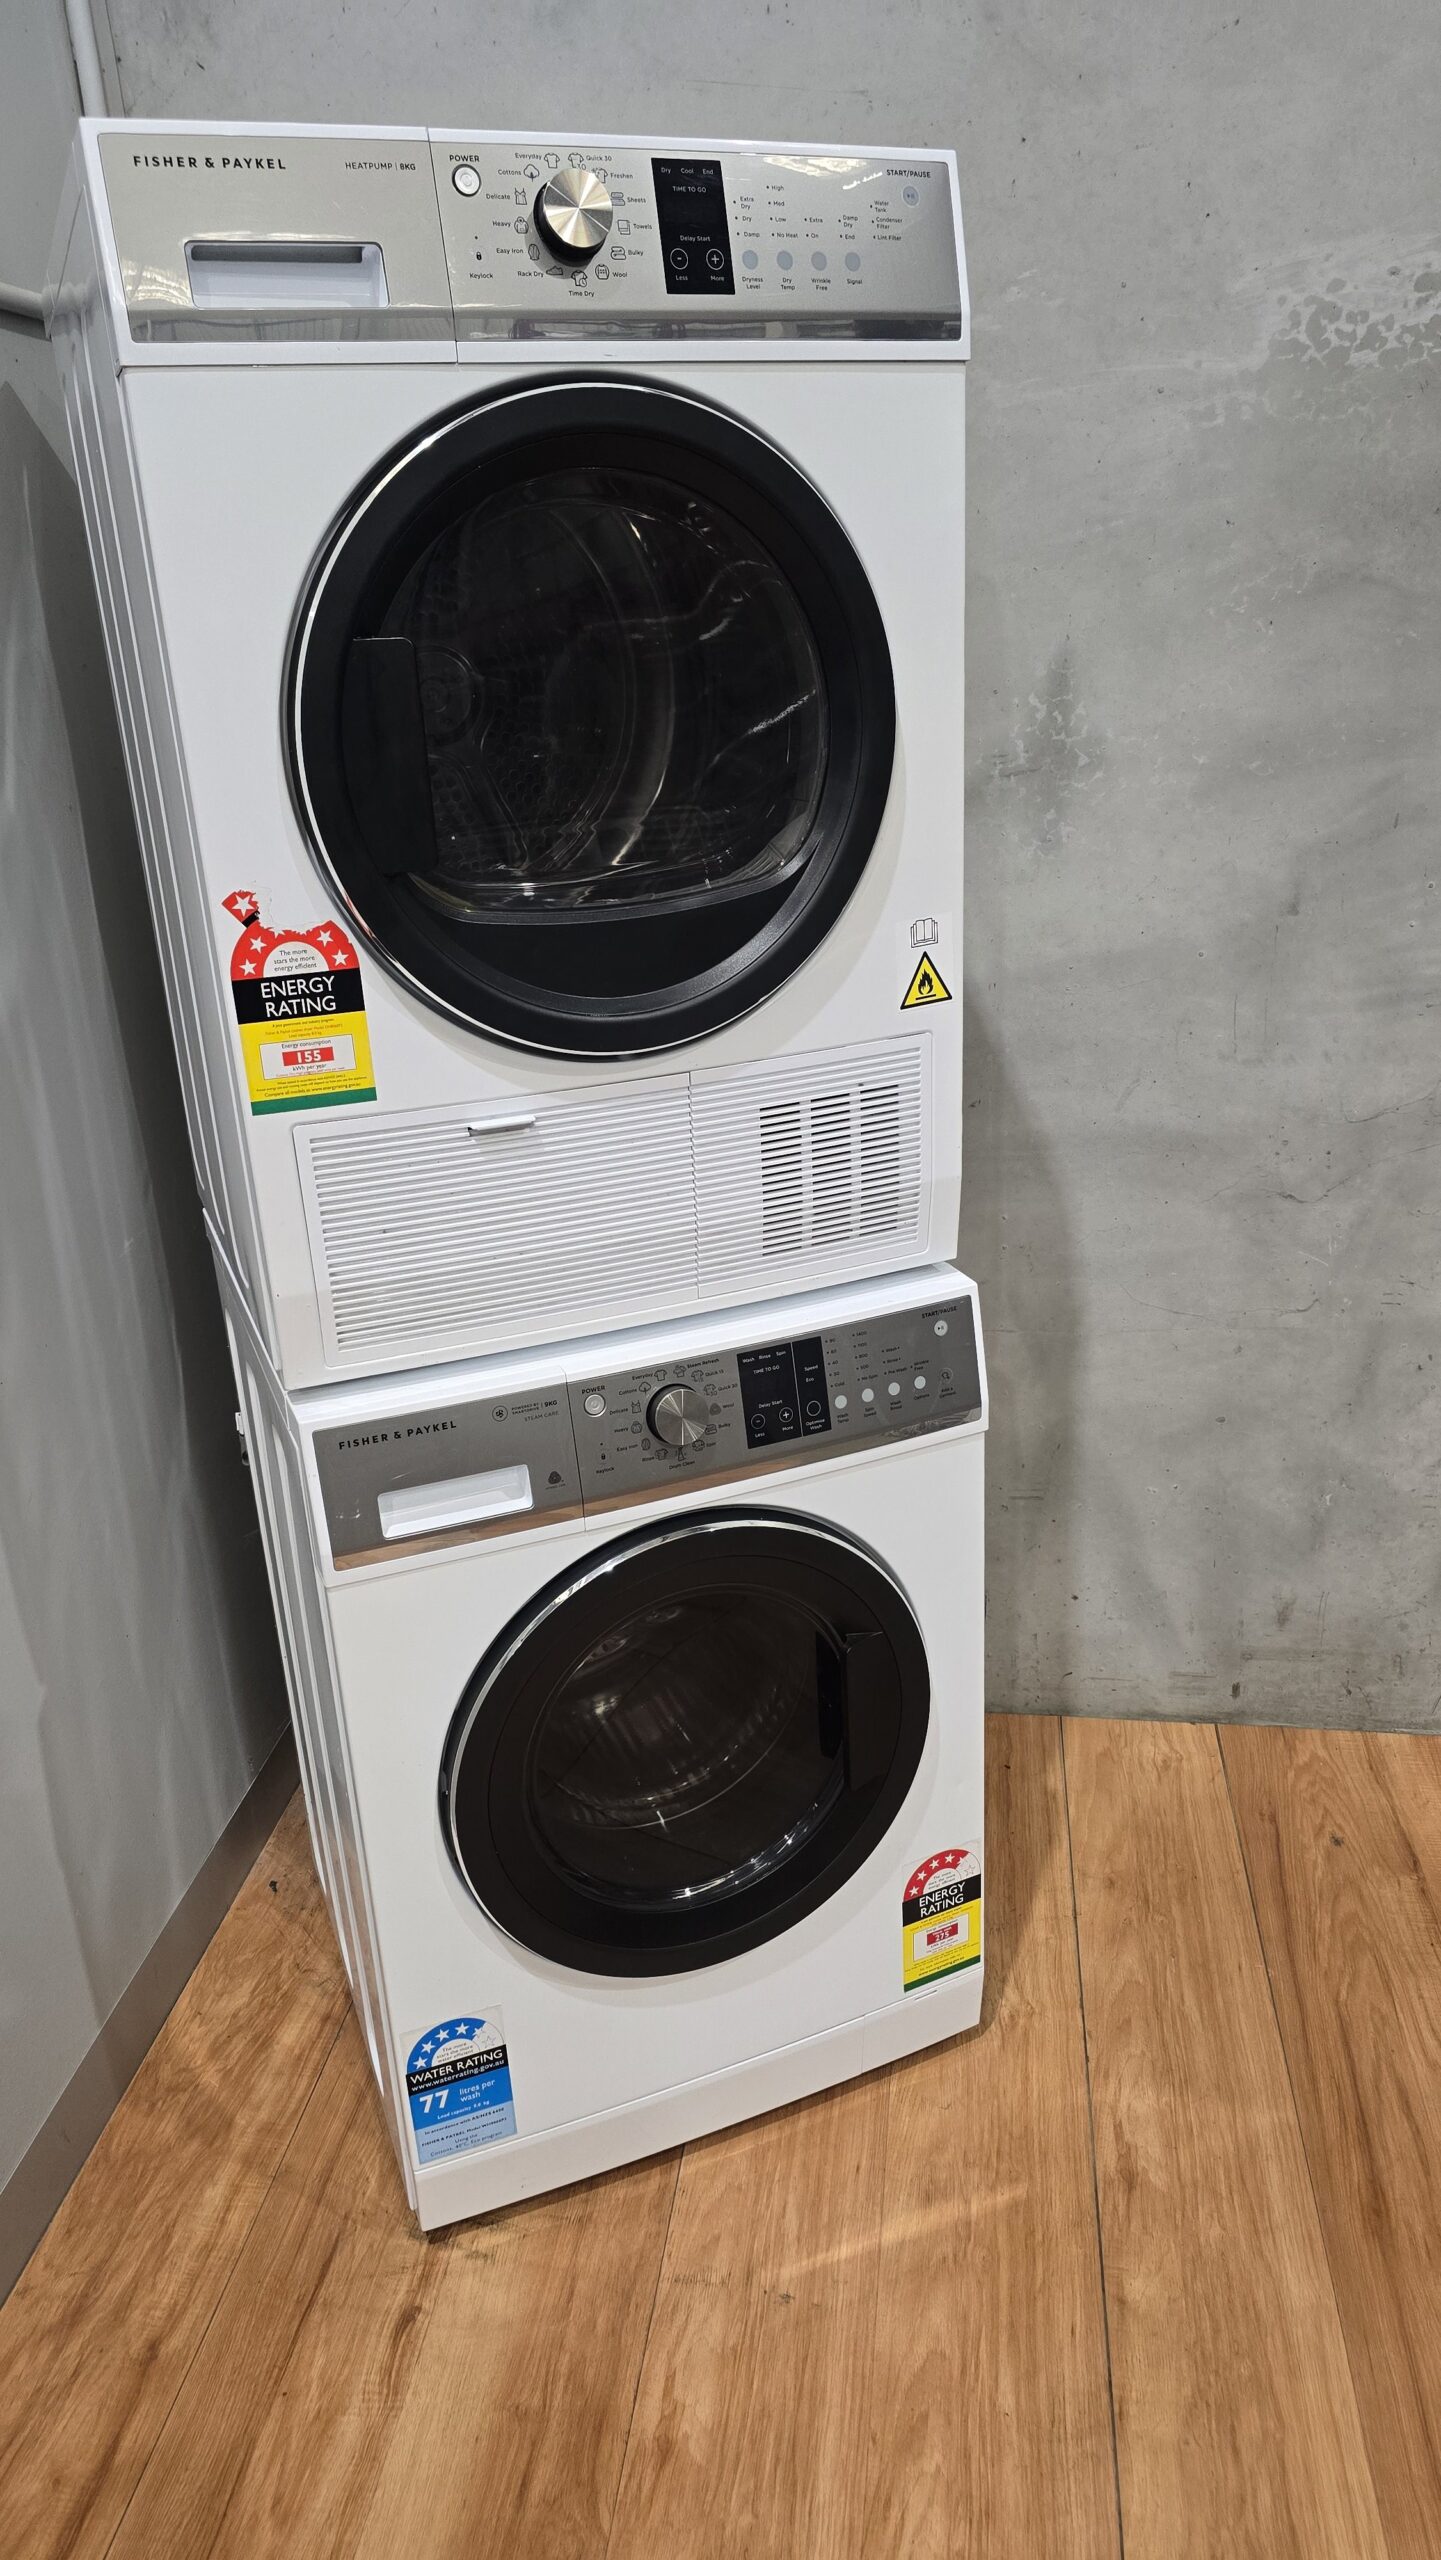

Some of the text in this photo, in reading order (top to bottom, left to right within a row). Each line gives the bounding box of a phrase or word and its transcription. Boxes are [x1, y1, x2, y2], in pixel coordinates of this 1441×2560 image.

[134, 156, 286, 170] FISHER & PAYKEL
[345, 162, 393, 170] HEATPUMP
[886, 169, 931, 178] START/PAUSE
[260, 976, 335, 998] ENERGY
[265, 996, 336, 1018] RATING
[297, 1050, 321, 1063] 155
[922, 1306, 957, 1318] START/PAUSE
[582, 1385, 605, 1394] POWER
[339, 1433, 388, 1449] FISHER
[407, 1420, 456, 1437] PAYKEL
[920, 1882, 965, 1907] ENERGY
[921, 1894, 964, 1918] RATING
[410, 2050, 502, 2084] WATER RATING
[412, 2060, 504, 2092] www.waterrating.gov.au
[459, 2080, 495, 2095] litres per
[419, 2089, 449, 2113] 77
[461, 2092, 480, 2102] wash
